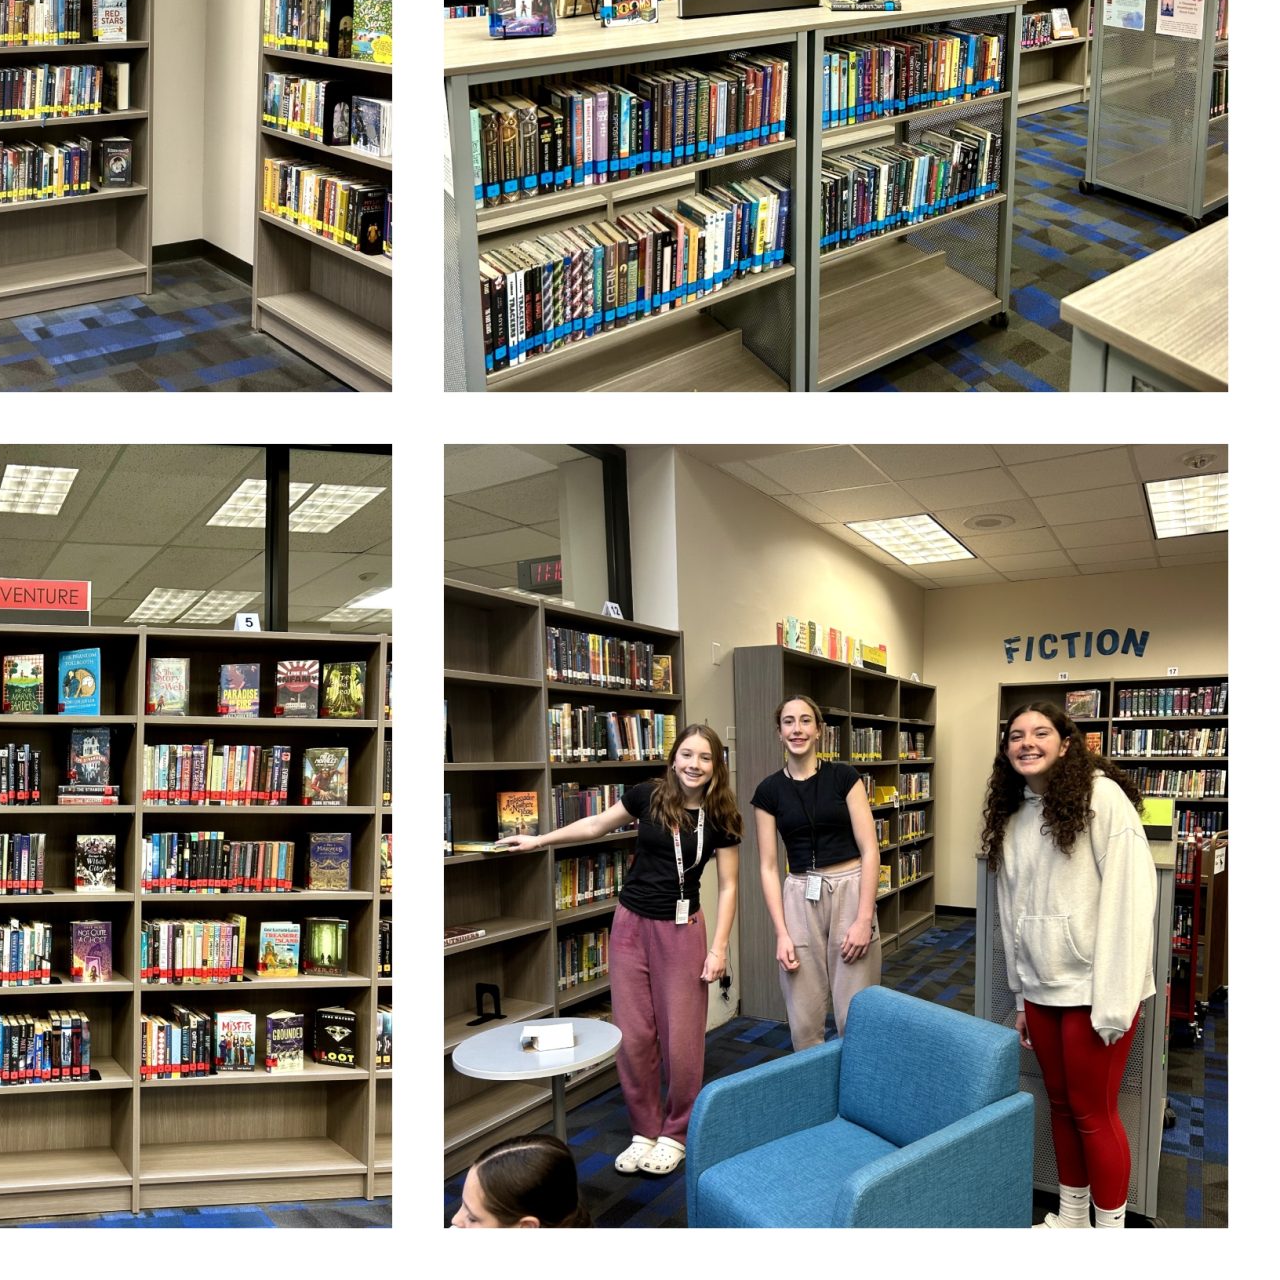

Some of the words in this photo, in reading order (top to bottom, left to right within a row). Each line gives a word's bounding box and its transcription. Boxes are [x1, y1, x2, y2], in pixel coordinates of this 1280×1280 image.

[101, 17, 124, 25] STARS
[606, 267, 616, 303] NEED
[508, 295, 516, 338] TRACKERS
[610, 605, 621, 616] 12
[245, 617, 253, 628] 5
[1003, 628, 1150, 664] FICTION
[1168, 668, 1178, 676] 17
[223, 688, 258, 699] PARADISE
[86, 857, 106, 865] Witch
[90, 929, 108, 937] QUITE
[84, 935, 106, 943] GHOST
[221, 1021, 253, 1031] MISFITS
[272, 1026, 303, 1040] GROUNDED
[323, 1051, 355, 1063] LOOT
